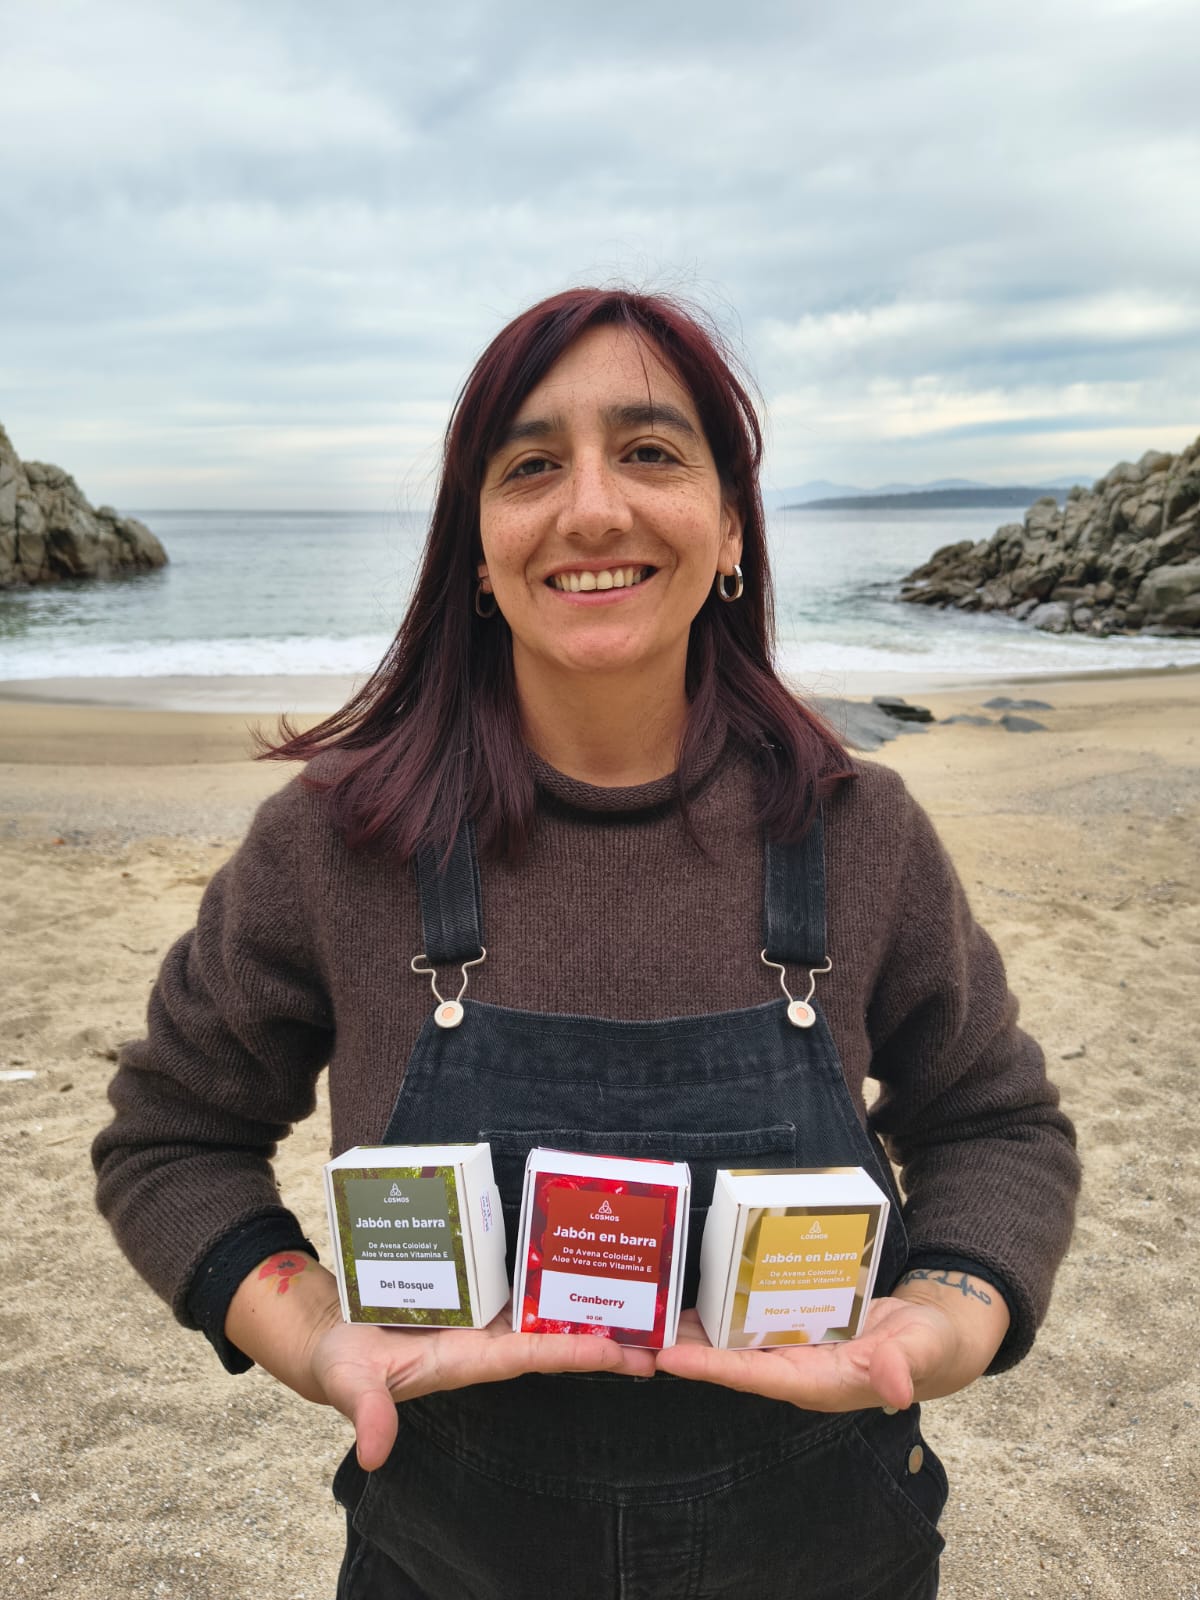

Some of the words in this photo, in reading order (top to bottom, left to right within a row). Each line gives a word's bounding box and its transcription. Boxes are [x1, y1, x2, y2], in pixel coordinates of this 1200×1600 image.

[356, 1217, 392, 1228] Jabón
[395, 1219, 408, 1228] en
[412, 1217, 446, 1228] barra
[590, 1213, 620, 1222] LOSMOS
[553, 1226, 596, 1241] Jabón
[600, 1234, 616, 1244] en
[620, 1233, 657, 1248] barra
[576, 1248, 600, 1258] Avena
[603, 1252, 636, 1262] Coloidal
[762, 1252, 802, 1264] Jabón
[806, 1253, 820, 1262] en
[824, 1251, 858, 1261] barra
[552, 1255, 570, 1264] Aloe
[573, 1258, 591, 1266] Vera
[609, 1261, 644, 1272] Vitamina
[380, 1280, 396, 1289] Del
[398, 1280, 434, 1292] Bosque
[569, 1293, 625, 1308] Cranberry
[764, 1306, 790, 1315] Mora
[800, 1304, 836, 1313] Vainilla
